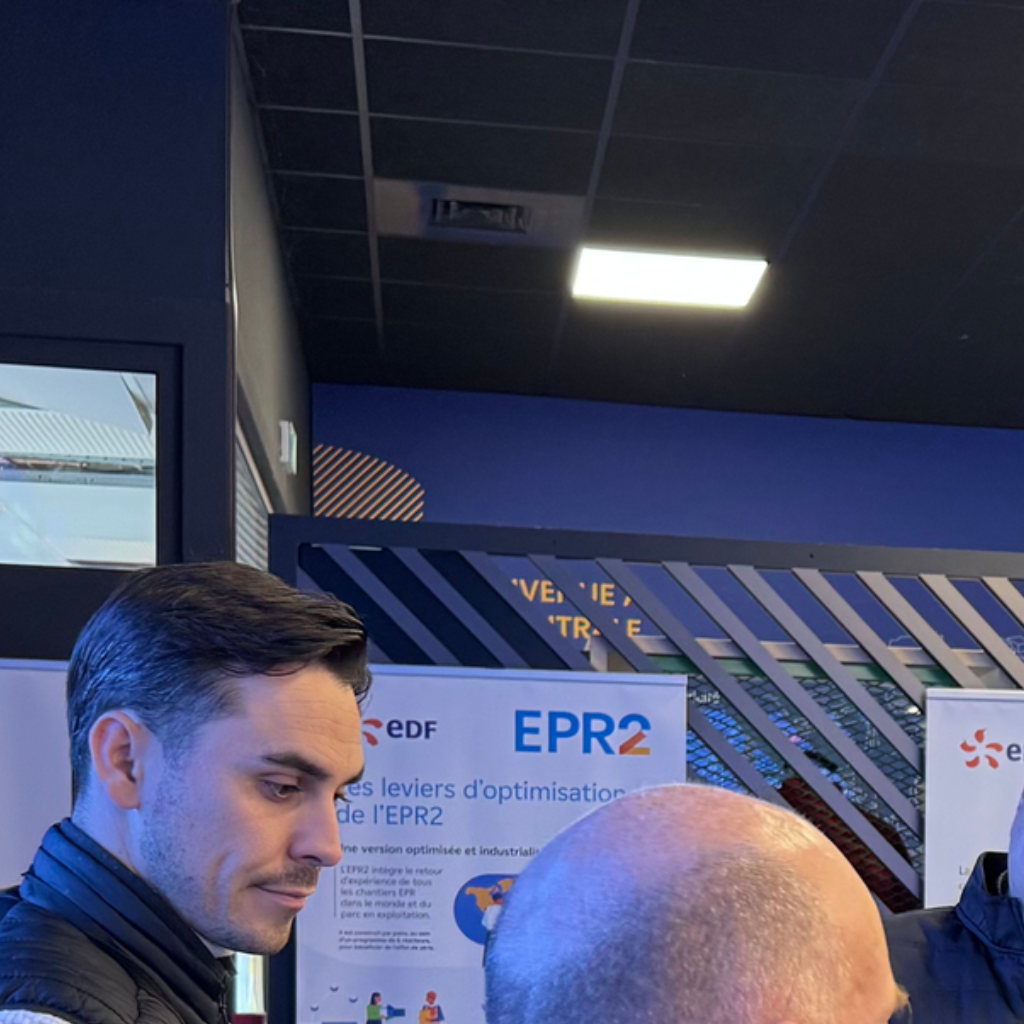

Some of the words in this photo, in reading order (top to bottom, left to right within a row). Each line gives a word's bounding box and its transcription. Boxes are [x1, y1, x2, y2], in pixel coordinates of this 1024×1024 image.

[515, 709, 651, 756] EPR2
[343, 781, 373, 798] es
[381, 778, 456, 799] leviers
[373, 804, 444, 826] l'EPR2
[361, 845, 403, 855] version
[406, 845, 462, 858] optimisée
[464, 846, 477, 856] et
